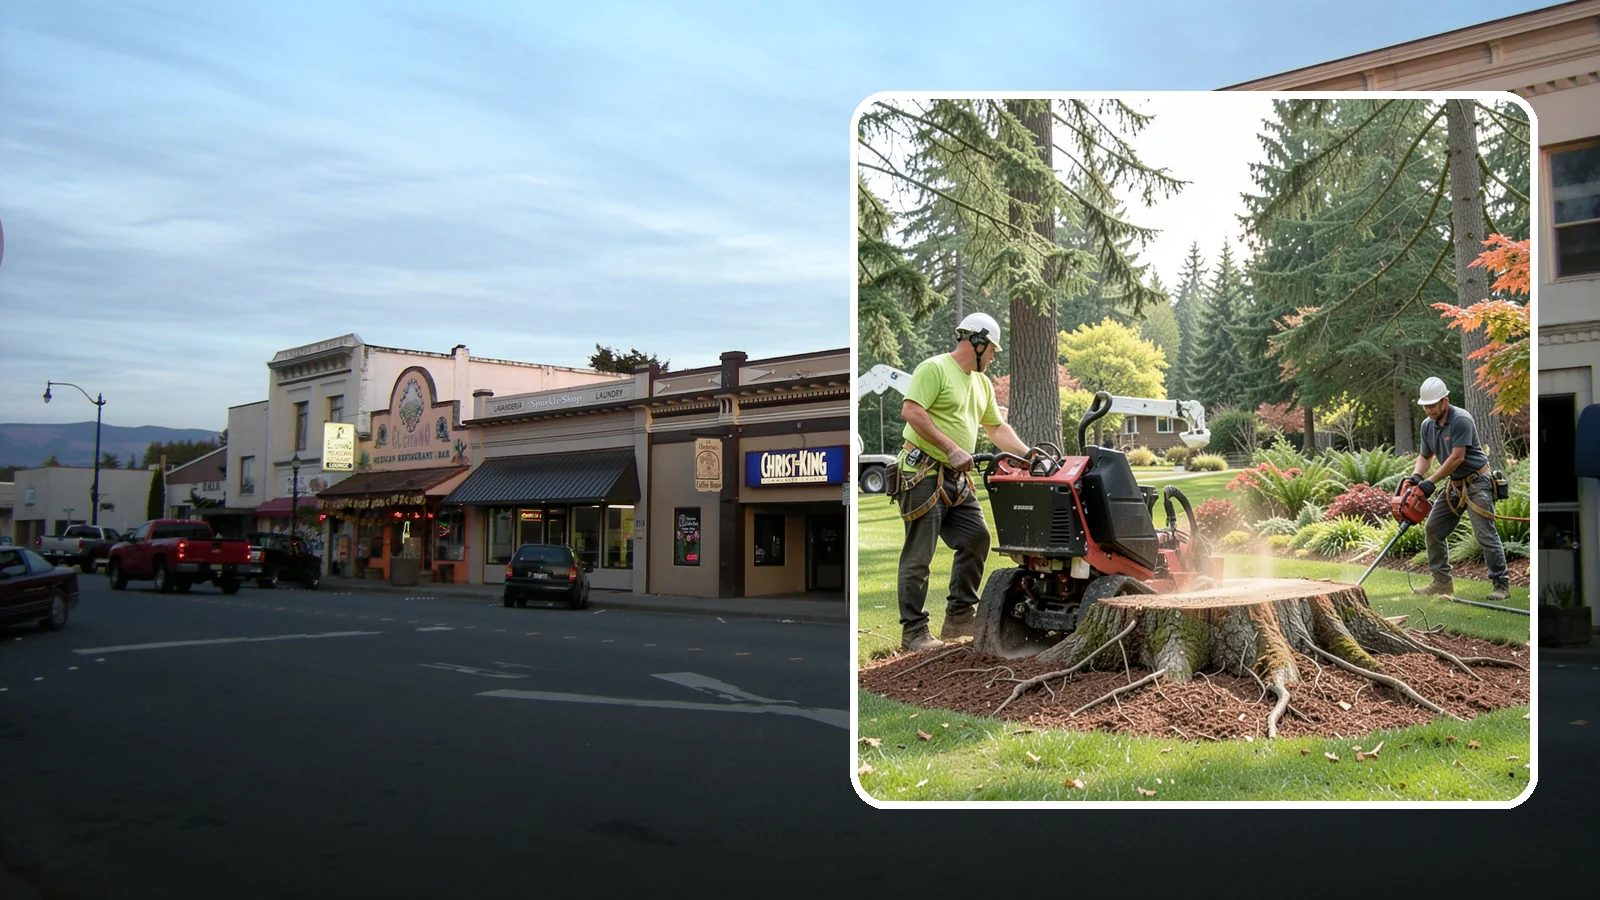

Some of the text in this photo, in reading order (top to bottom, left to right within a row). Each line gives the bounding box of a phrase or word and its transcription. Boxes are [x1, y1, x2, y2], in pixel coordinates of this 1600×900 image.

[595, 389, 624, 400] LAUNDRY
[493, 402, 523, 413] LAVANDERIA
[530, 394, 583, 409] Sparkle Shop
[373, 450, 450, 464] MEXICAN RESTAURANT BAR
